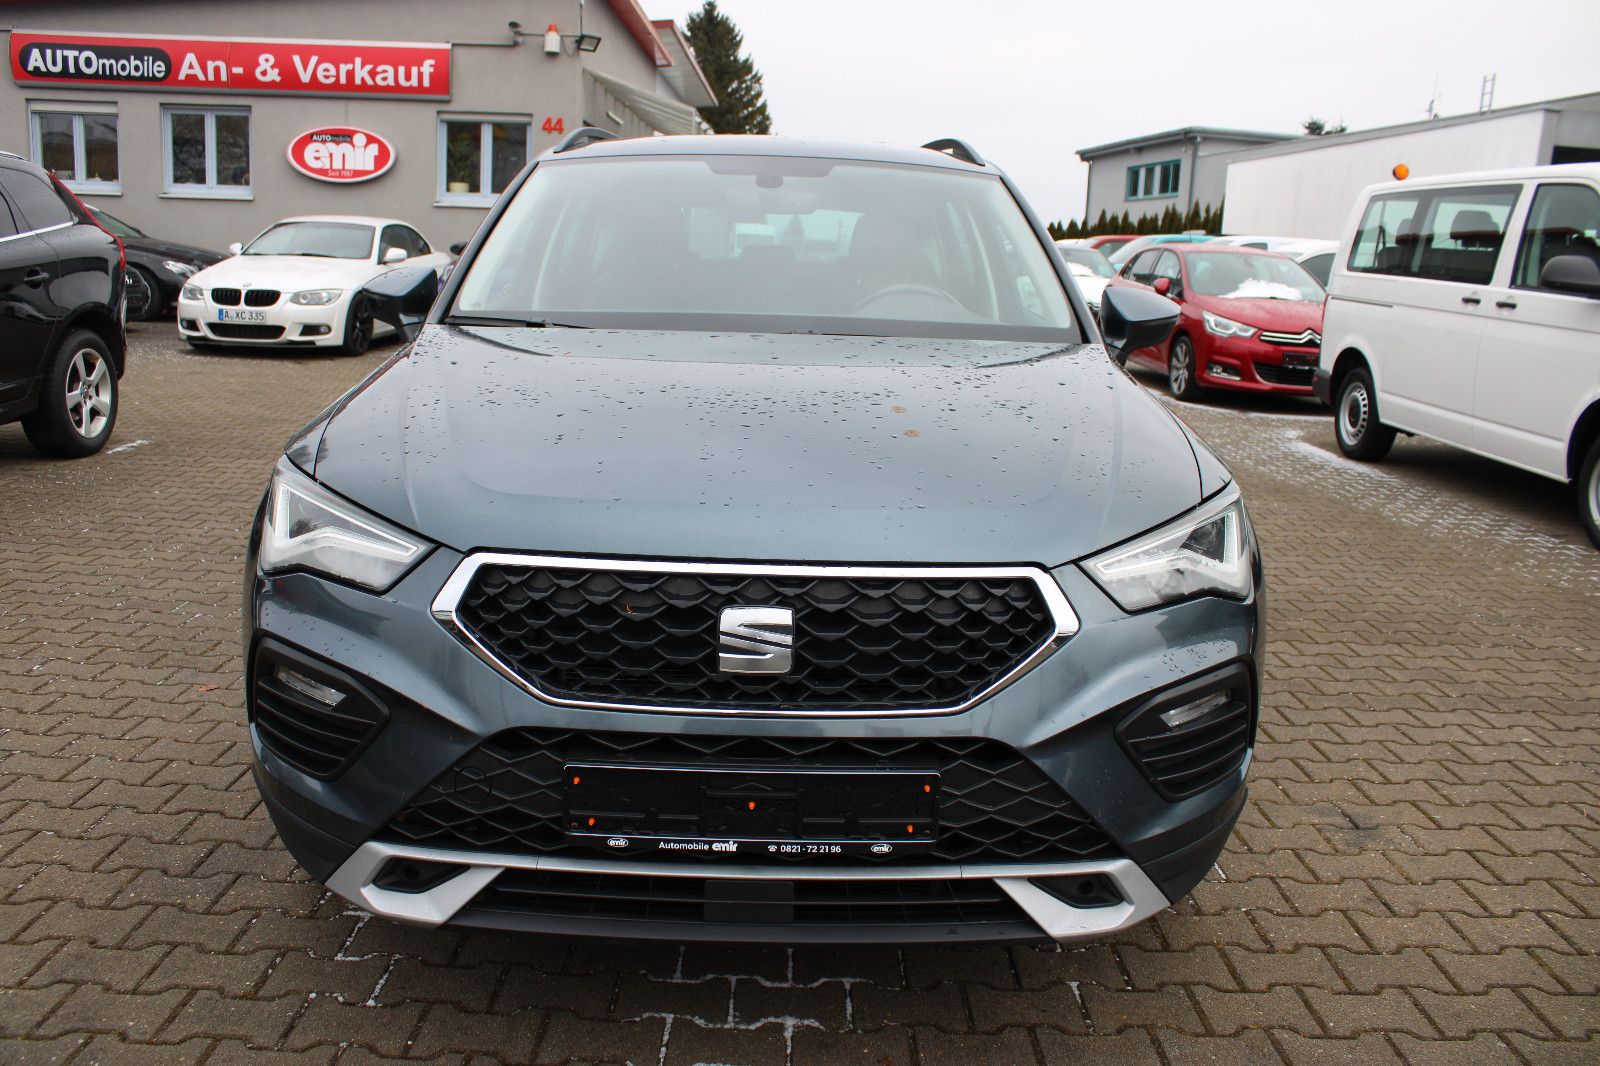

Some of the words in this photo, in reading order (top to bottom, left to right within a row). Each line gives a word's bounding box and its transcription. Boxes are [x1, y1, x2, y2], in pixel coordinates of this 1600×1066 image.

[27, 48, 166, 78] AUTOmobile
[178, 52, 244, 82] An-
[254, 53, 282, 83] &
[292, 54, 435, 88] Verkauf
[542, 116, 564, 134] 44
[303, 132, 379, 170] emir
[659, 841, 709, 850] Automobile
[712, 840, 738, 852] emir
